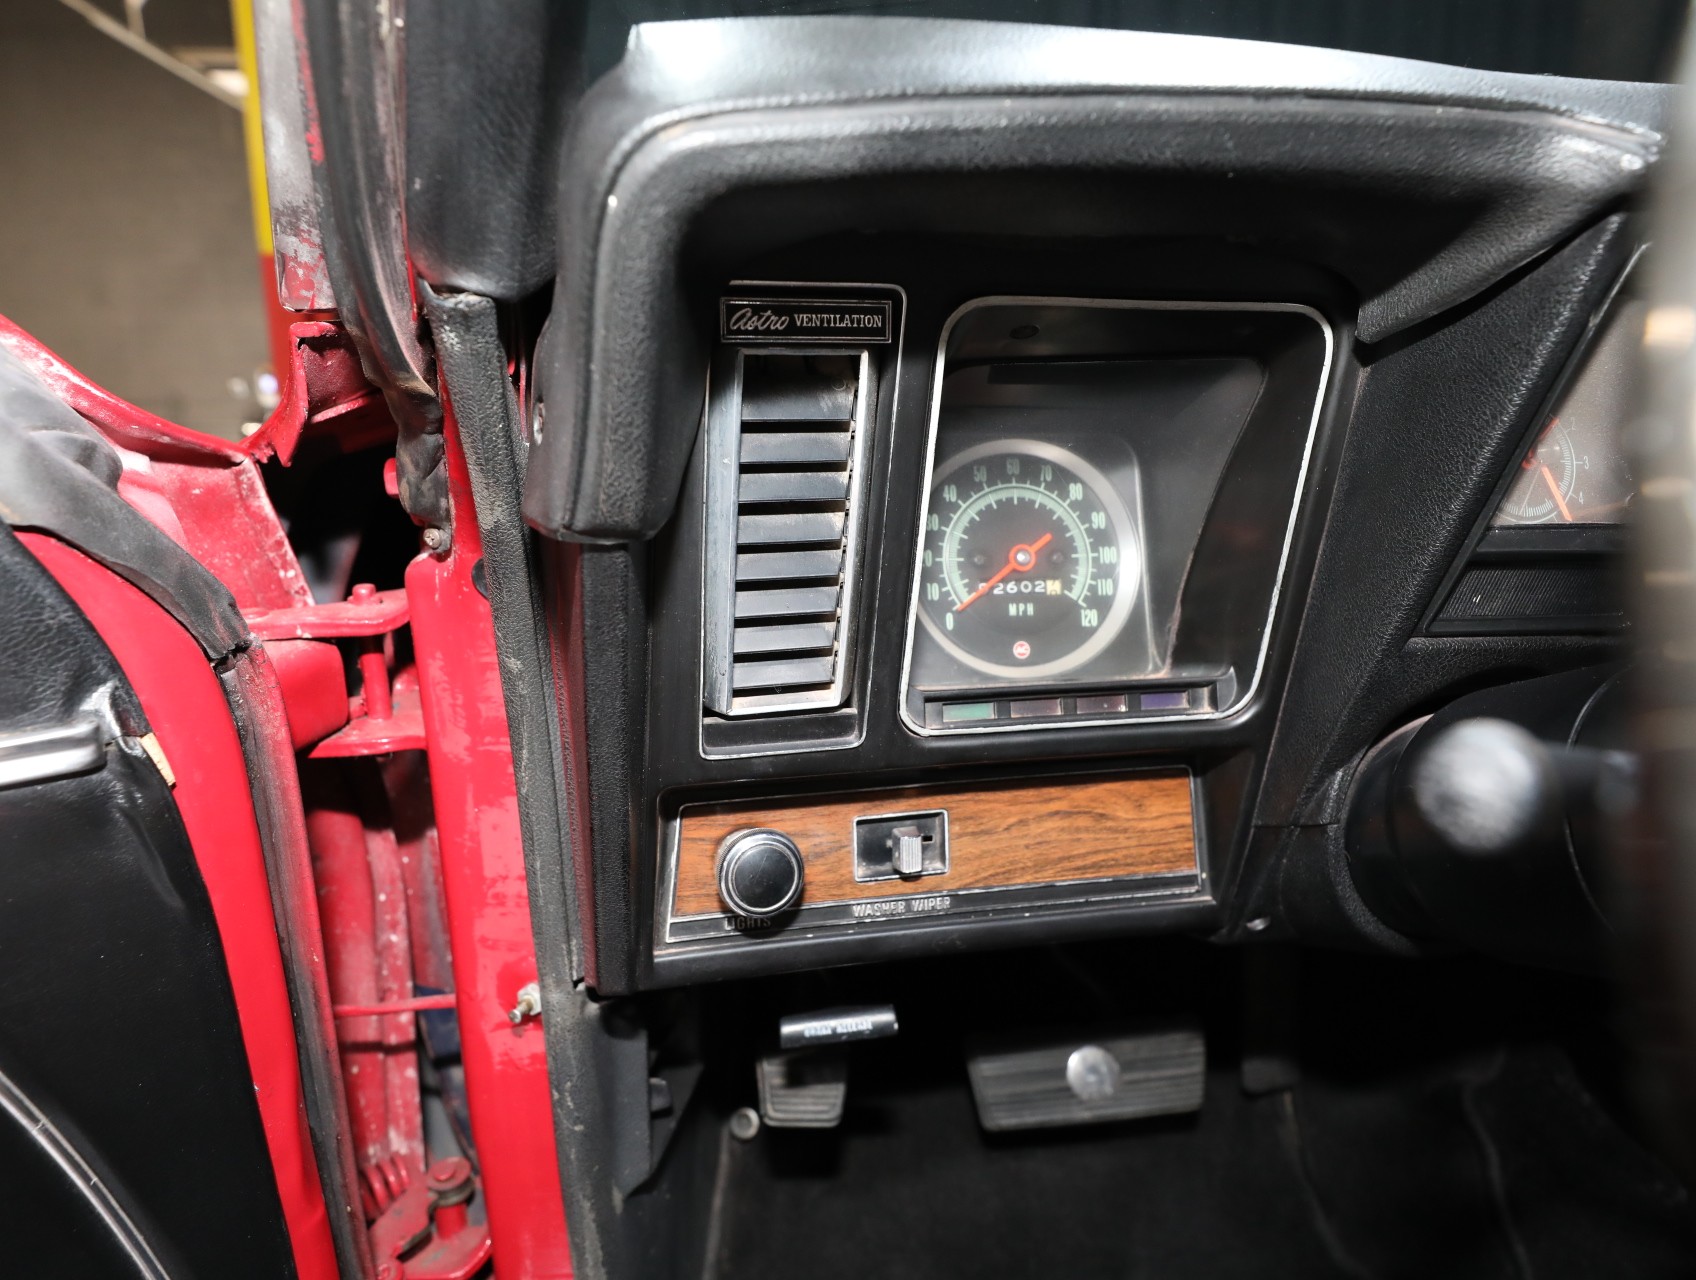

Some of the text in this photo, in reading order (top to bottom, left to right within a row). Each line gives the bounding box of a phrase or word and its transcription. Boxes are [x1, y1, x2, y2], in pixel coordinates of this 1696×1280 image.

[729, 307, 882, 331] Astro VENTILATION
[1006, 458, 1020, 475] 60
[1583, 455, 1589, 470] 3
[973, 465, 987, 483] 50
[1040, 464, 1053, 481] 70
[942, 482, 957, 502] 40
[1069, 482, 1083, 501] 80
[1578, 491, 1584, 505] 4
[1091, 511, 1106, 530] 90
[1099, 547, 1117, 564] 100
[926, 582, 940, 601] 10
[1097, 579, 1113, 596] 110
[1008, 602, 1034, 617] MPH
[1080, 609, 1098, 627] 120
[945, 611, 954, 631] 0
[852, 896, 951, 917] WASHER WIPER
[724, 916, 771, 930] LIGHTS
